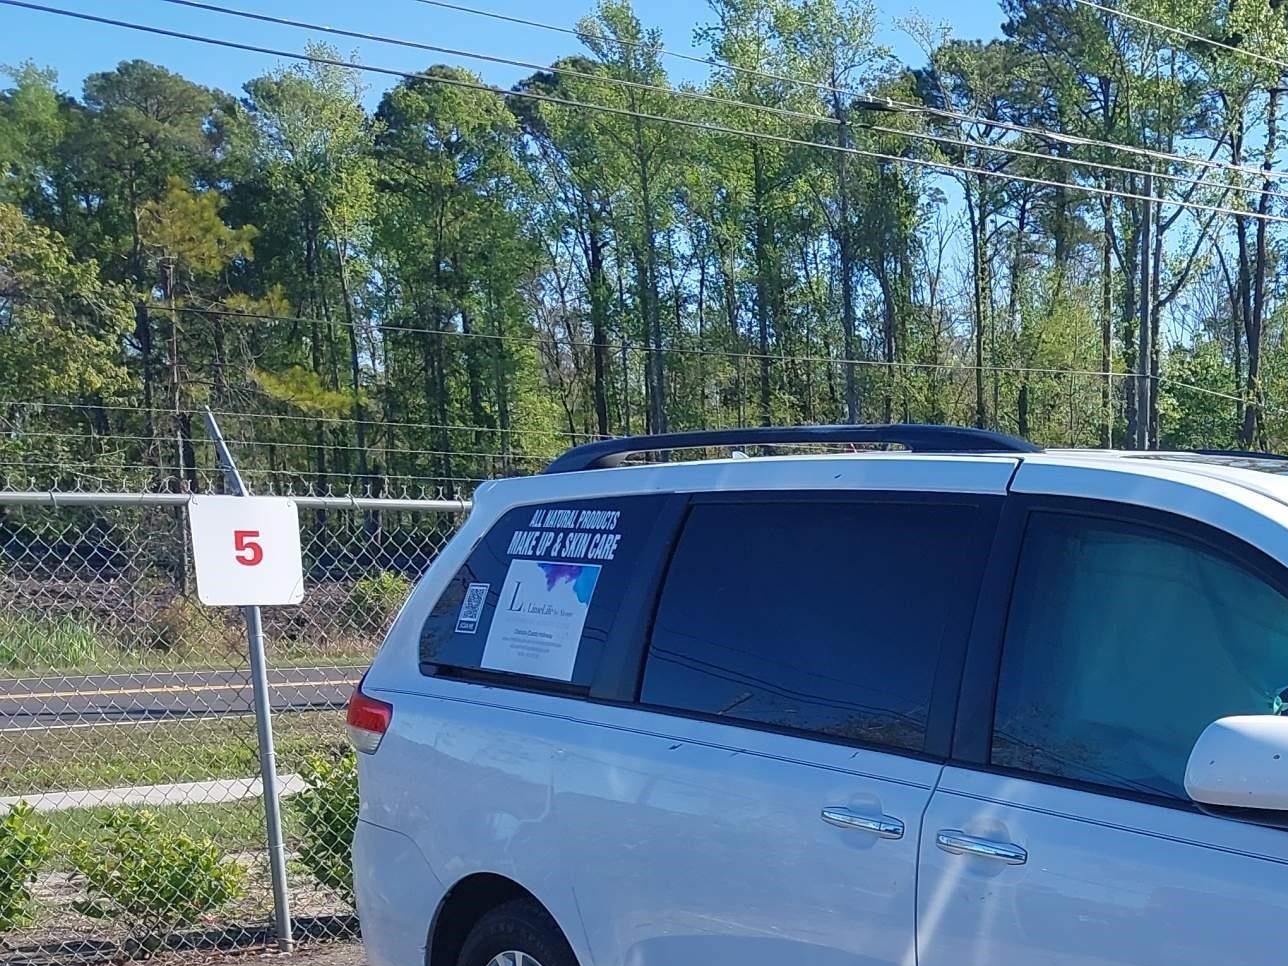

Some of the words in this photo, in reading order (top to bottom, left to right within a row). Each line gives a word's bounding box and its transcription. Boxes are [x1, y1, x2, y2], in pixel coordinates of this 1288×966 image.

[529, 509, 546, 528] ALL
[542, 509, 579, 529] NATURAL
[575, 510, 621, 530] PRODUCTS
[234, 530, 264, 567] 5
[507, 530, 541, 556] MAKE
[535, 531, 555, 556] UP
[550, 532, 564, 557] &
[561, 532, 592, 559] SKIN
[587, 533, 622, 560] CARE
